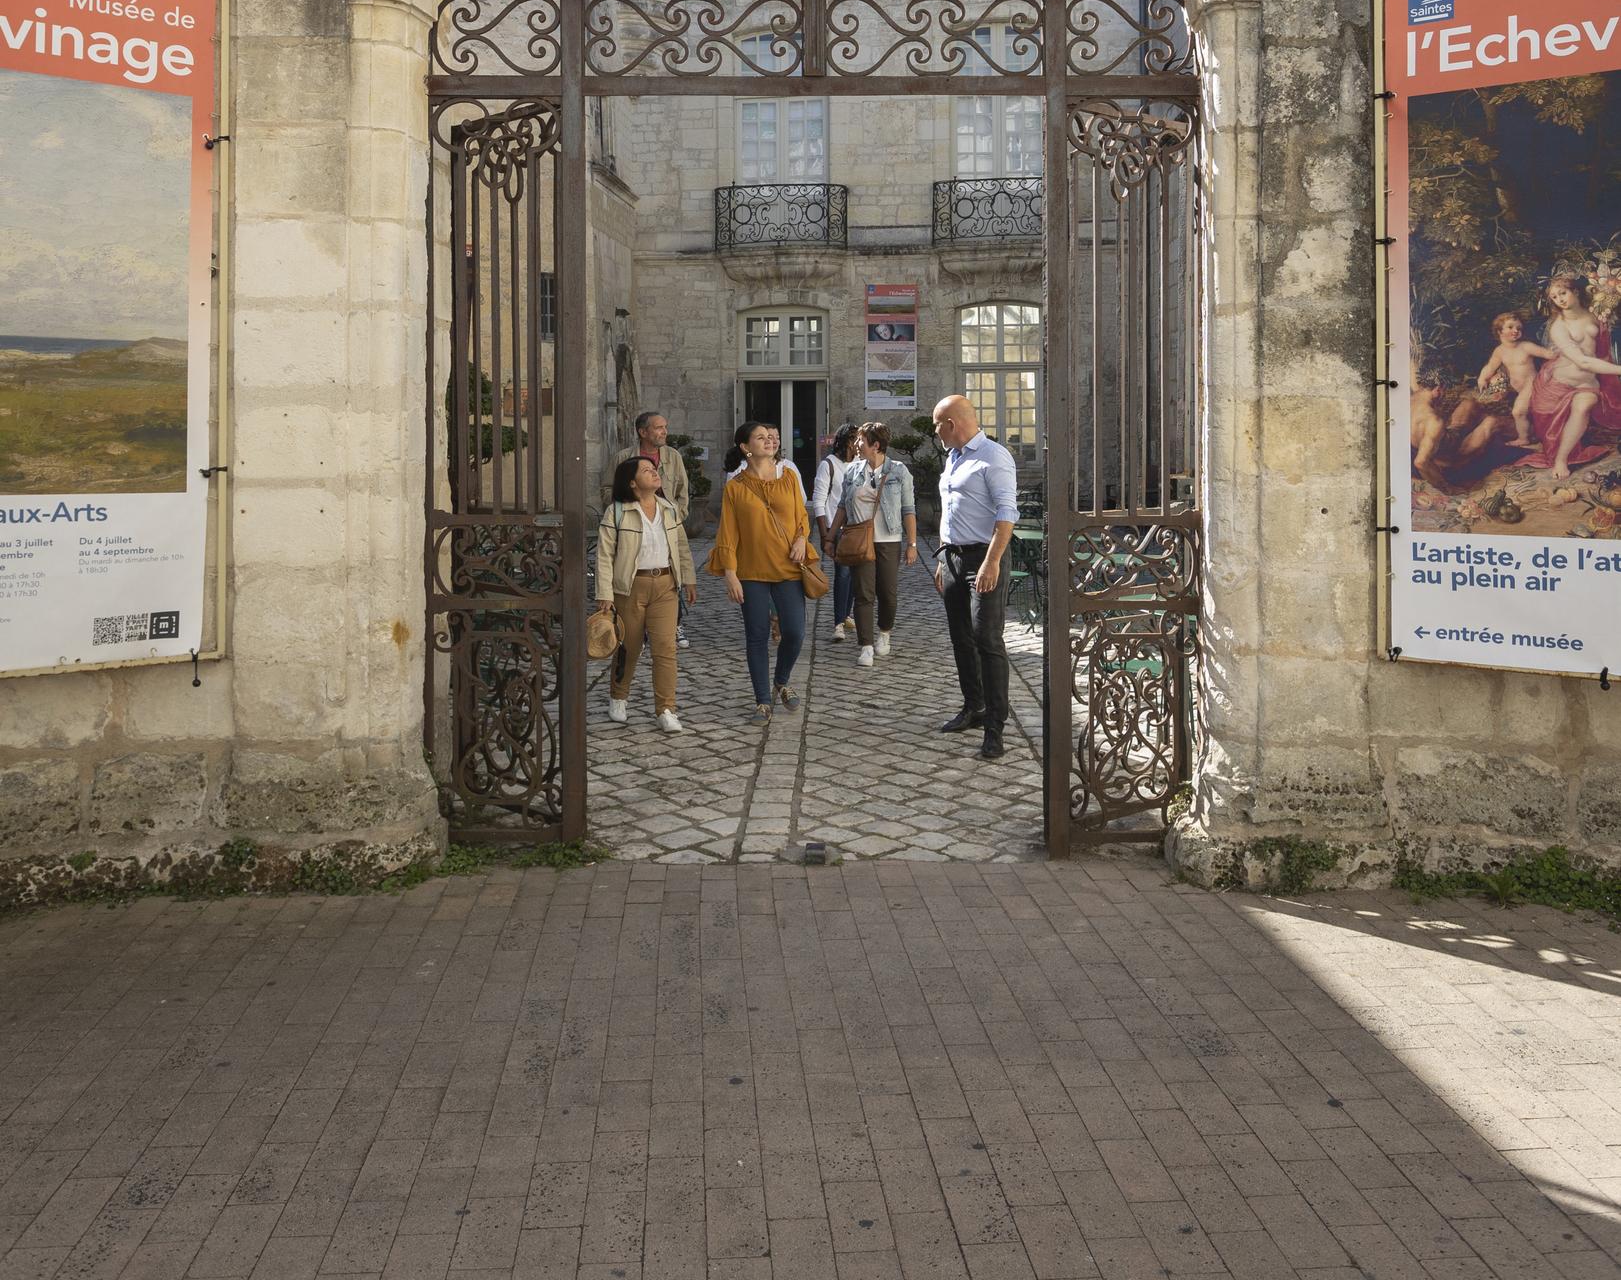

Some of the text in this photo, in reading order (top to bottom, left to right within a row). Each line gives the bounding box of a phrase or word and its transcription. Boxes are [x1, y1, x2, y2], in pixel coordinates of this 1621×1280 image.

[164, 7, 195, 29] de
[1410, 3, 1452, 18] Saintes
[0, 8, 194, 84] vinage
[1407, 15, 1620, 77] l'Echev
[15, 539, 22, 547] 3
[24, 538, 53, 549] juillet
[79, 537, 93, 545] Du
[105, 536, 132, 546] juillet
[94, 548, 100, 556] 4
[103, 547, 154, 557] septembre
[1412, 542, 1522, 570] L'artiste,
[1531, 547, 1568, 569] de
[1411, 566, 1562, 591] au plein air
[1435, 627, 1584, 651] entrée musée
